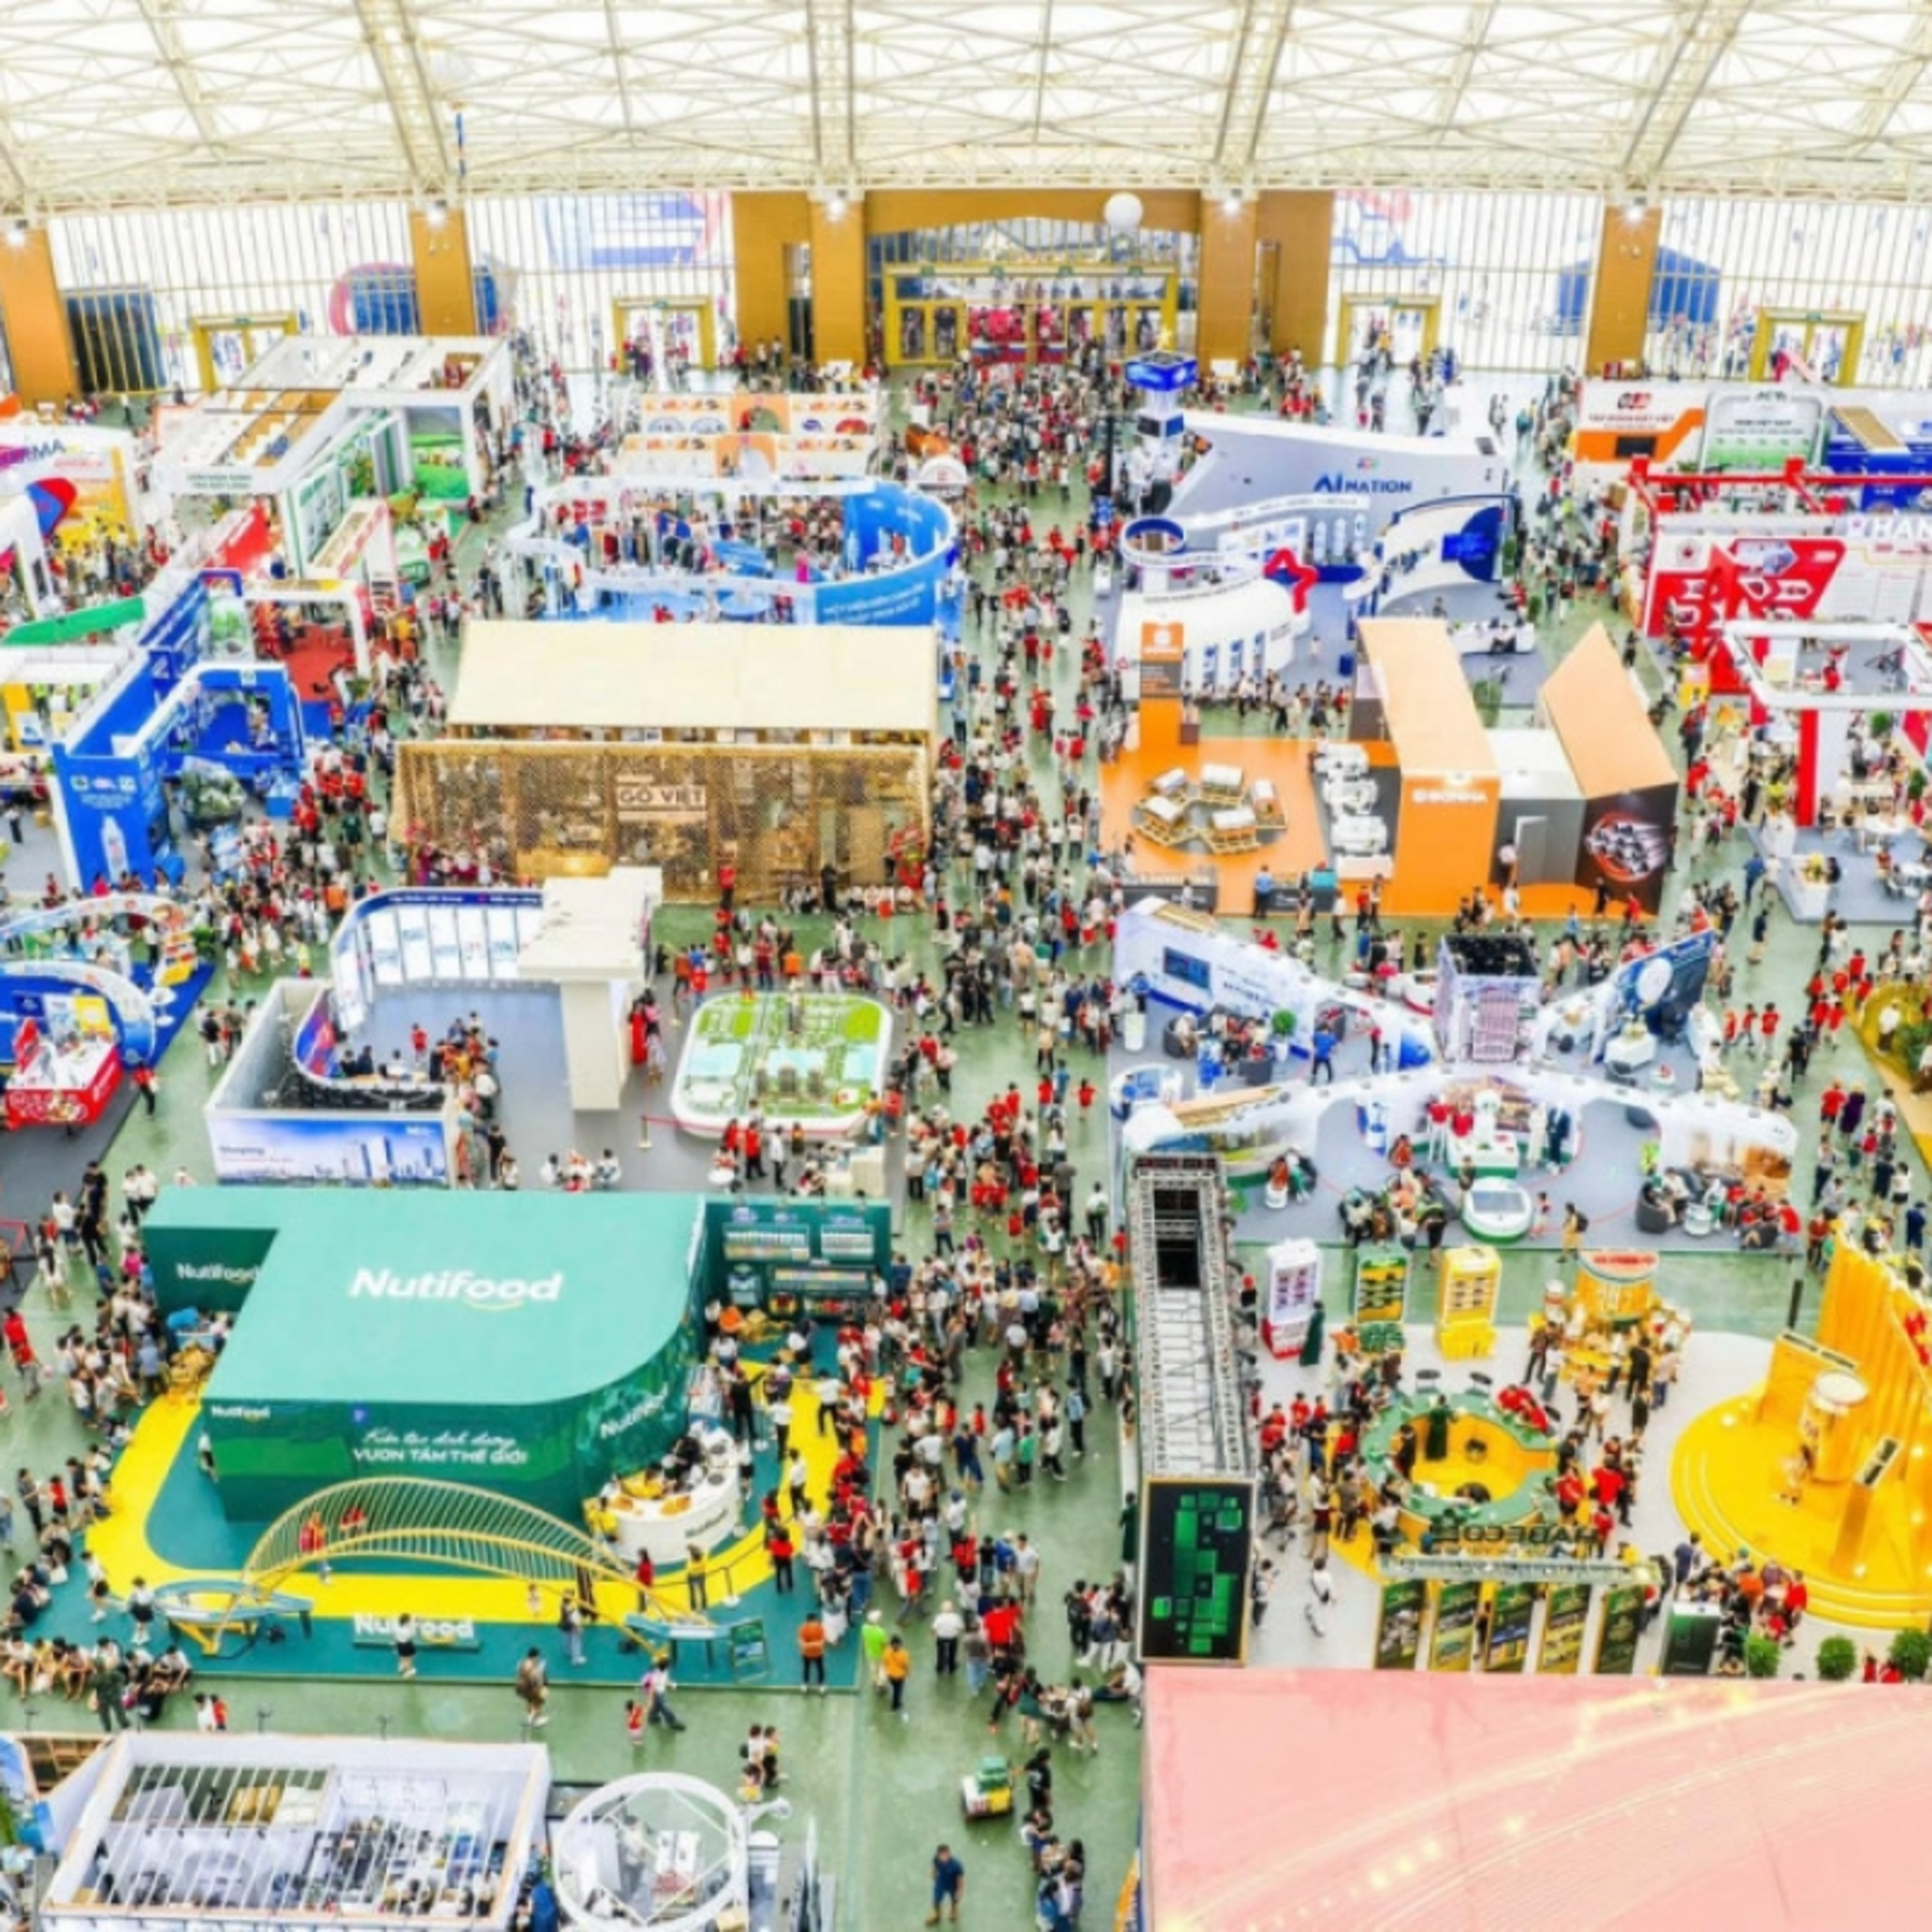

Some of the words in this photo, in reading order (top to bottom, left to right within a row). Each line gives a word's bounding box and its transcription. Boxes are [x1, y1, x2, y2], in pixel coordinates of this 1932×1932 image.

[1312, 472, 1343, 493] AI
[1345, 480, 1413, 493] NATION
[349, 1267, 563, 1302] Nutifood
